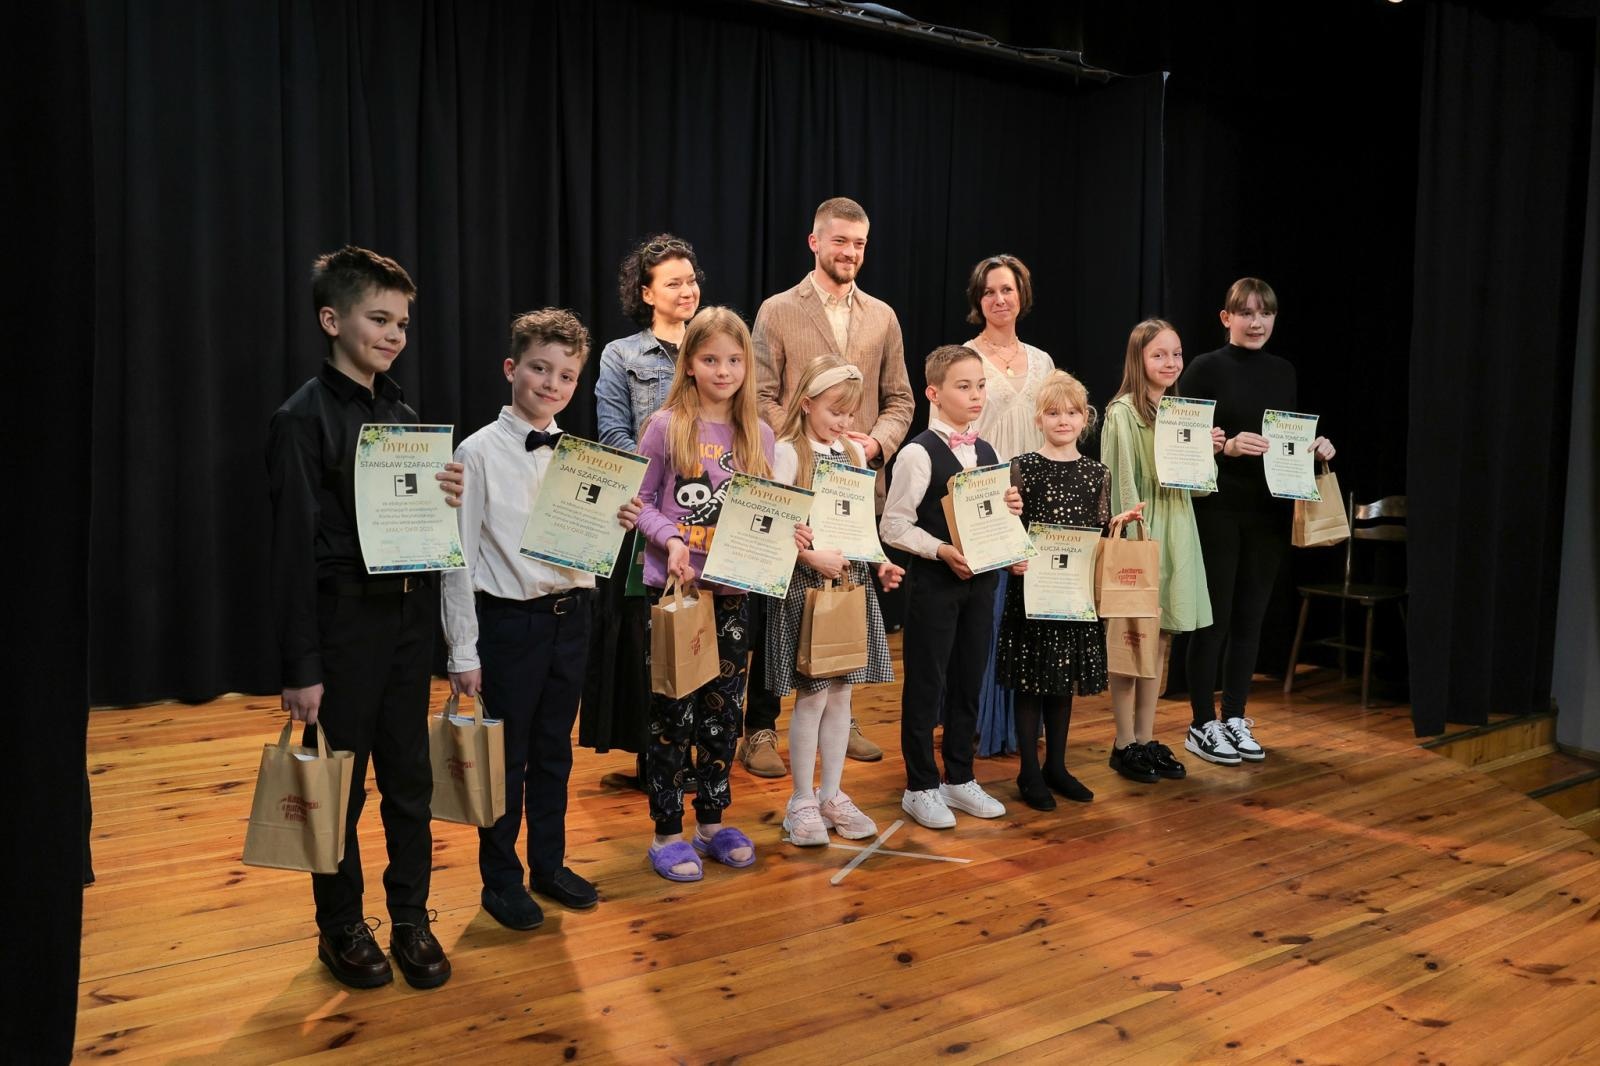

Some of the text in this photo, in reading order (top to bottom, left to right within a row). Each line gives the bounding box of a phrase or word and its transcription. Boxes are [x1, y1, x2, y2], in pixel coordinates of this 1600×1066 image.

[382, 442, 429, 453] DYPLOM
[359, 460, 446, 469] STANISŁAW SZAFARCZY
[577, 452, 624, 474] DYPLOM
[559, 463, 577, 475] JAN
[576, 469, 629, 492] SZAFARCZYK
[749, 486, 792, 506] DYPLOM
[730, 497, 780, 517] MAŁGORZATA
[1045, 533, 1082, 543] DYPLOM
